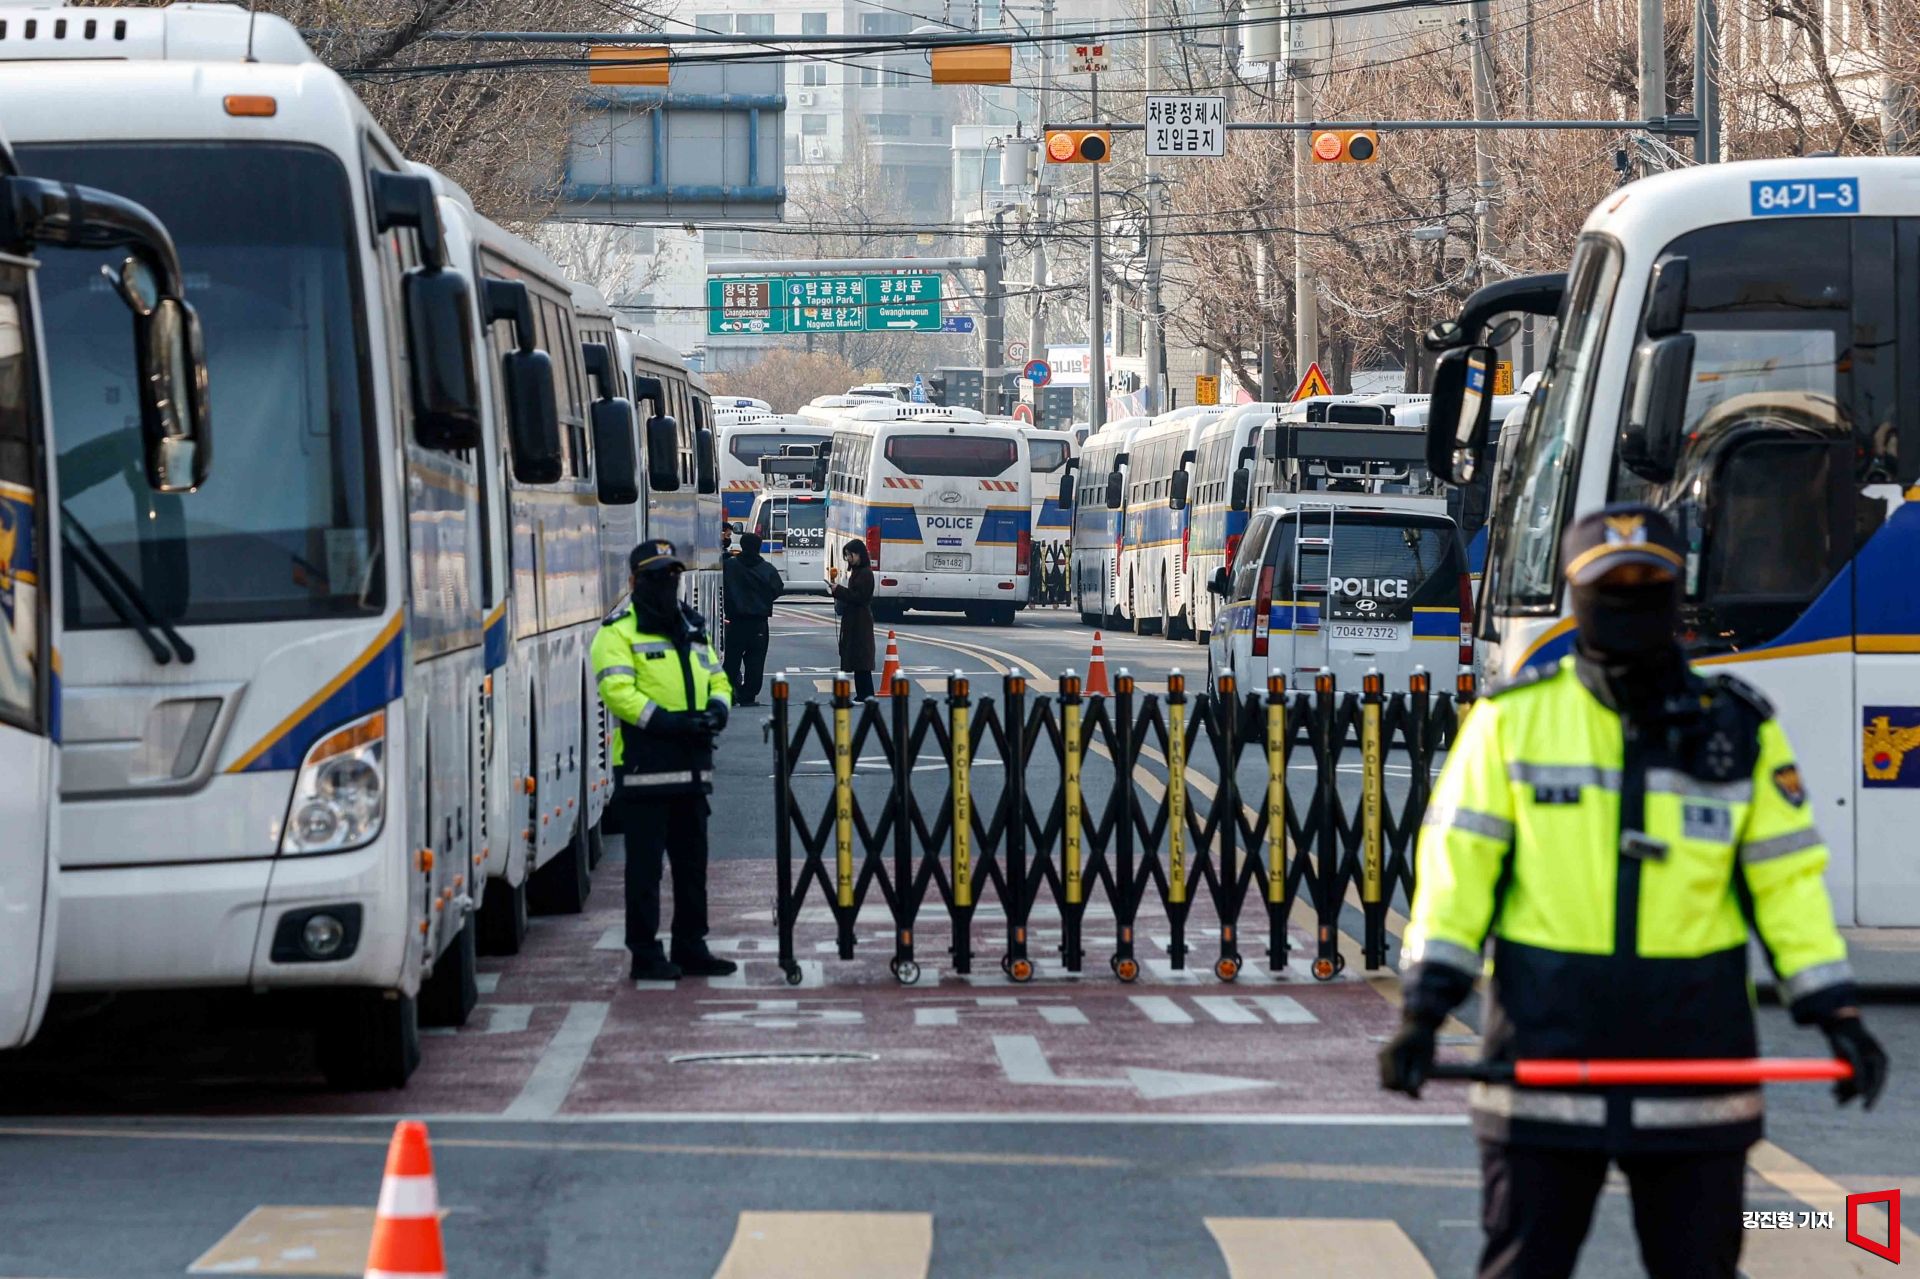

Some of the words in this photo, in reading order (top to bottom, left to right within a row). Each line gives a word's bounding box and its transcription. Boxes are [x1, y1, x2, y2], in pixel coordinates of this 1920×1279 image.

[1149, 102, 1222, 125] 차량정체시
[1157, 128, 1214, 151] 진입금지
[1758, 183, 1854, 210] 84기-3
[725, 283, 759, 297] 창덕궁
[805, 281, 861, 296] 탑골공원
[880, 280, 923, 293] 광화문
[806, 296, 834, 305] Tapgol
[836, 296, 854, 304] Park
[879, 308, 929, 318] Gwanghwamun
[807, 320, 835, 330] Nagwon
[837, 319, 861, 328] Market
[927, 517, 974, 529] POLICE
[787, 528, 824, 537] POLICE
[1330, 577, 1408, 598] POLICE
[956, 743, 967, 819] POLICE
[1366, 739, 1377, 817] POLICE
[957, 836, 967, 885] LINE
[1367, 832, 1377, 882] LINE
